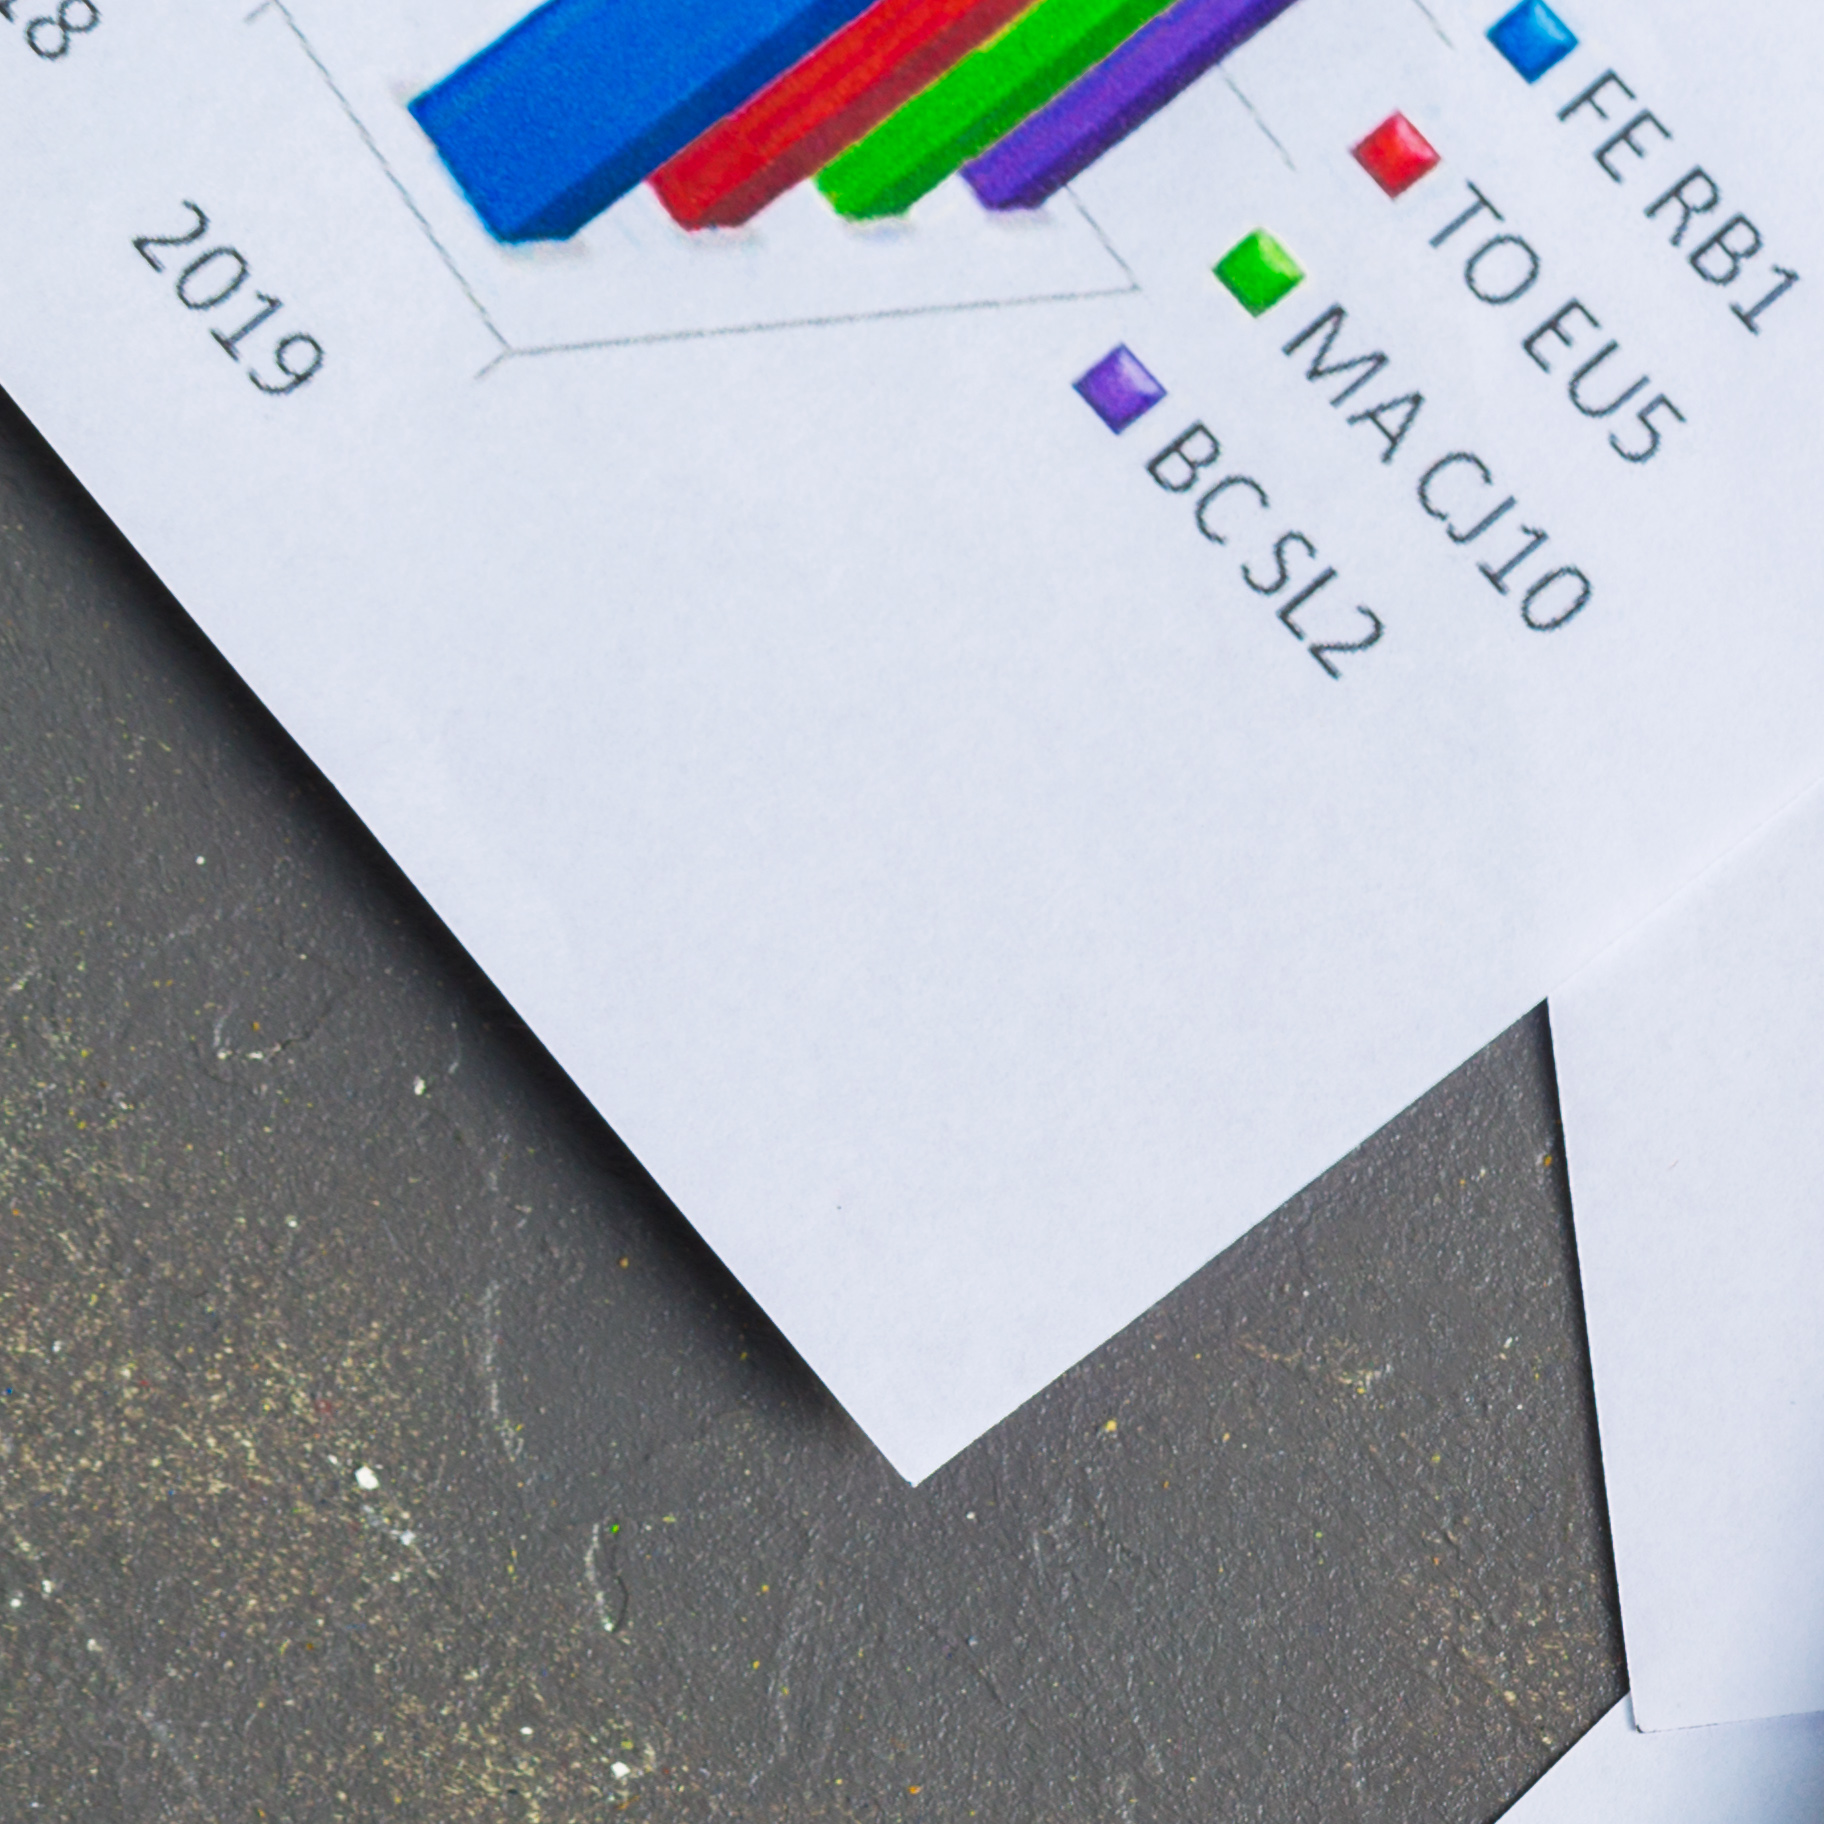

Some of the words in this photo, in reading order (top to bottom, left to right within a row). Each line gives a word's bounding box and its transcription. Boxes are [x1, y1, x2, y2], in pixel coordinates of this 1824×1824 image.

[132, 201, 324, 395] 2019
[1430, 181, 1540, 305] TO
[1522, 298, 1685, 463] EU5
[1557, 69, 1671, 183] FE
[1645, 166, 1799, 334] RB1
[1146, 422, 1269, 544] BC
[1241, 531, 1384, 679] SL2
[1282, 304, 1424, 463] MA
[1417, 452, 1591, 632] CJ10
